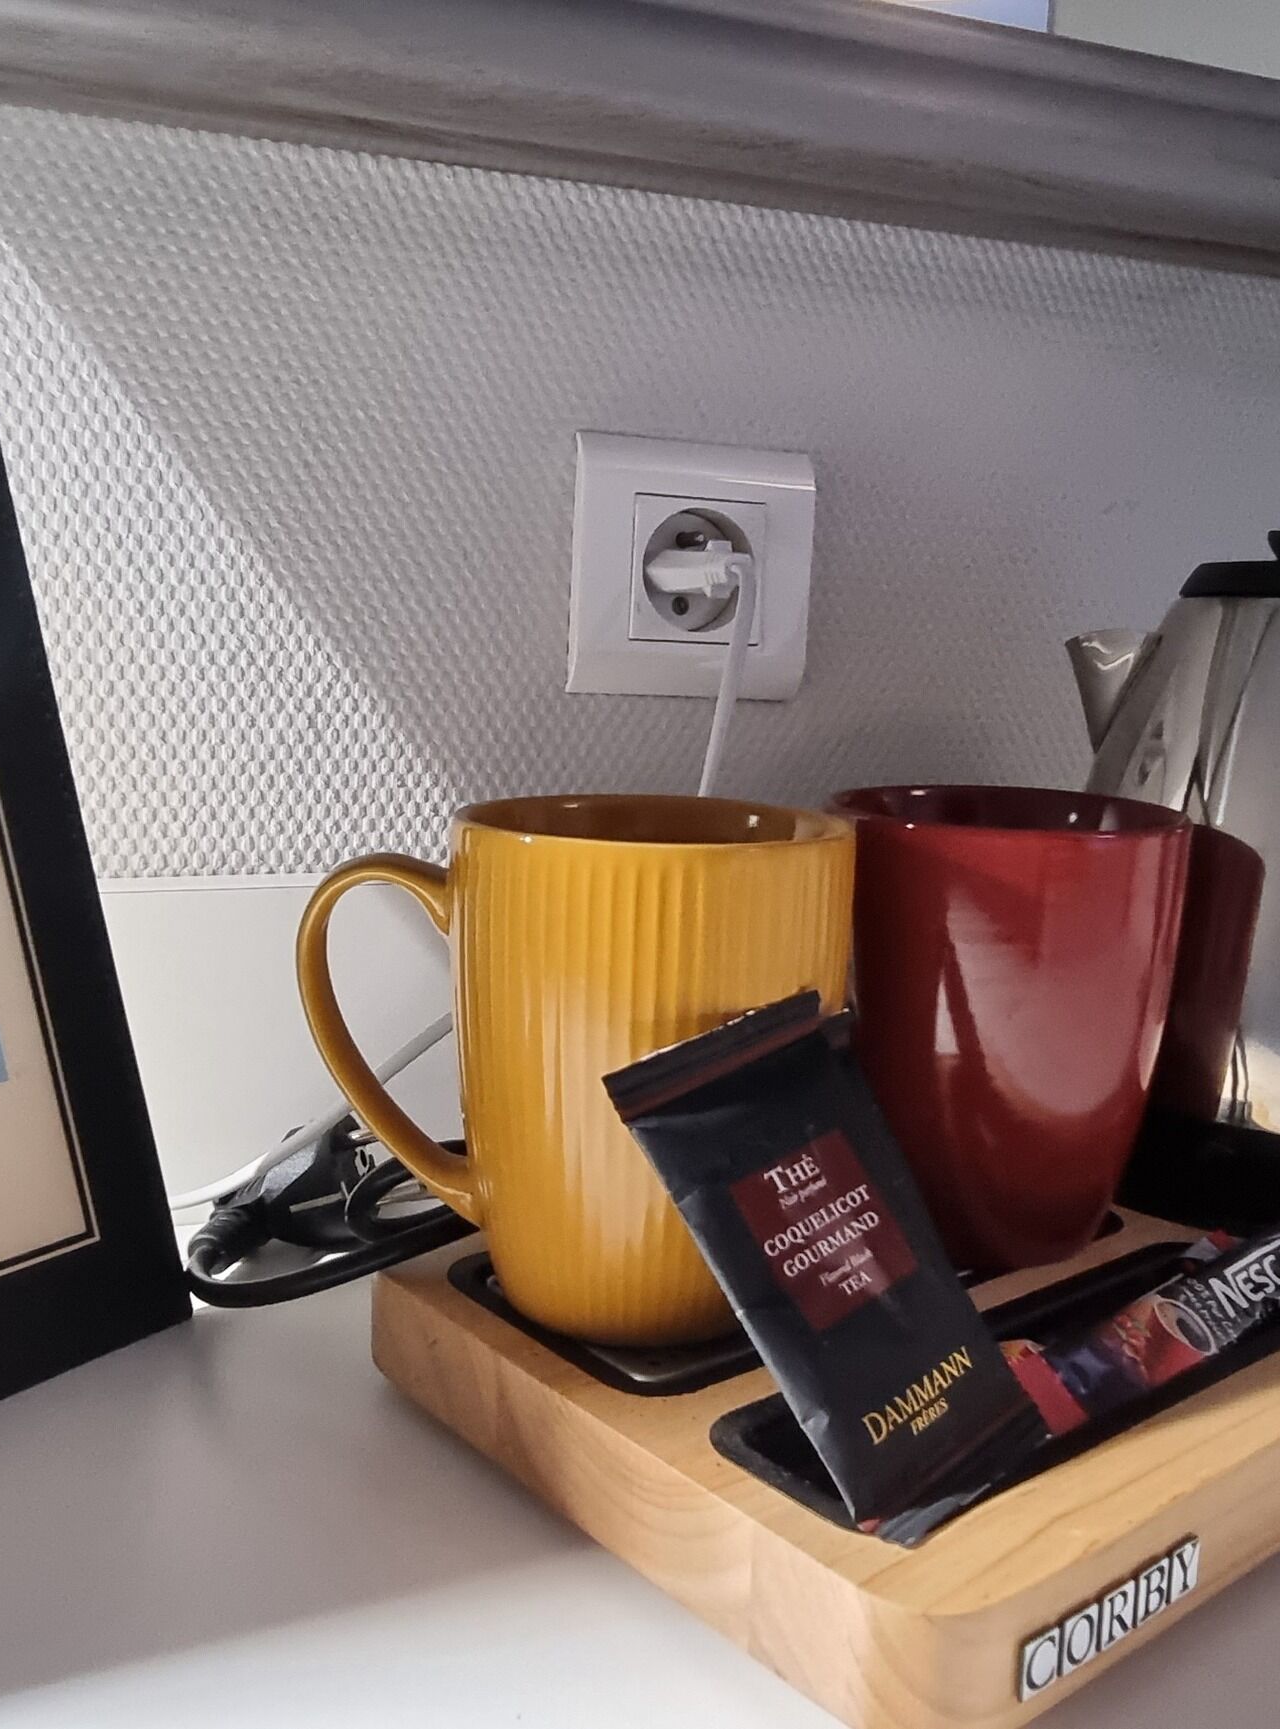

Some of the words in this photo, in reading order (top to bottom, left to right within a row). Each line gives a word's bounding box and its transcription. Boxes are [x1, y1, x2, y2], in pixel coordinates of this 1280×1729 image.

[764, 1154, 820, 1193] THÉ
[764, 1184, 871, 1257] COQUELICOT
[783, 1211, 880, 1277] GOURMAND
[838, 1271, 873, 1295] TEA
[861, 1345, 973, 1445] DAMMANN
[910, 1397, 949, 1436] FRÈRES
[1026, 1539, 1200, 1690] CORBY
